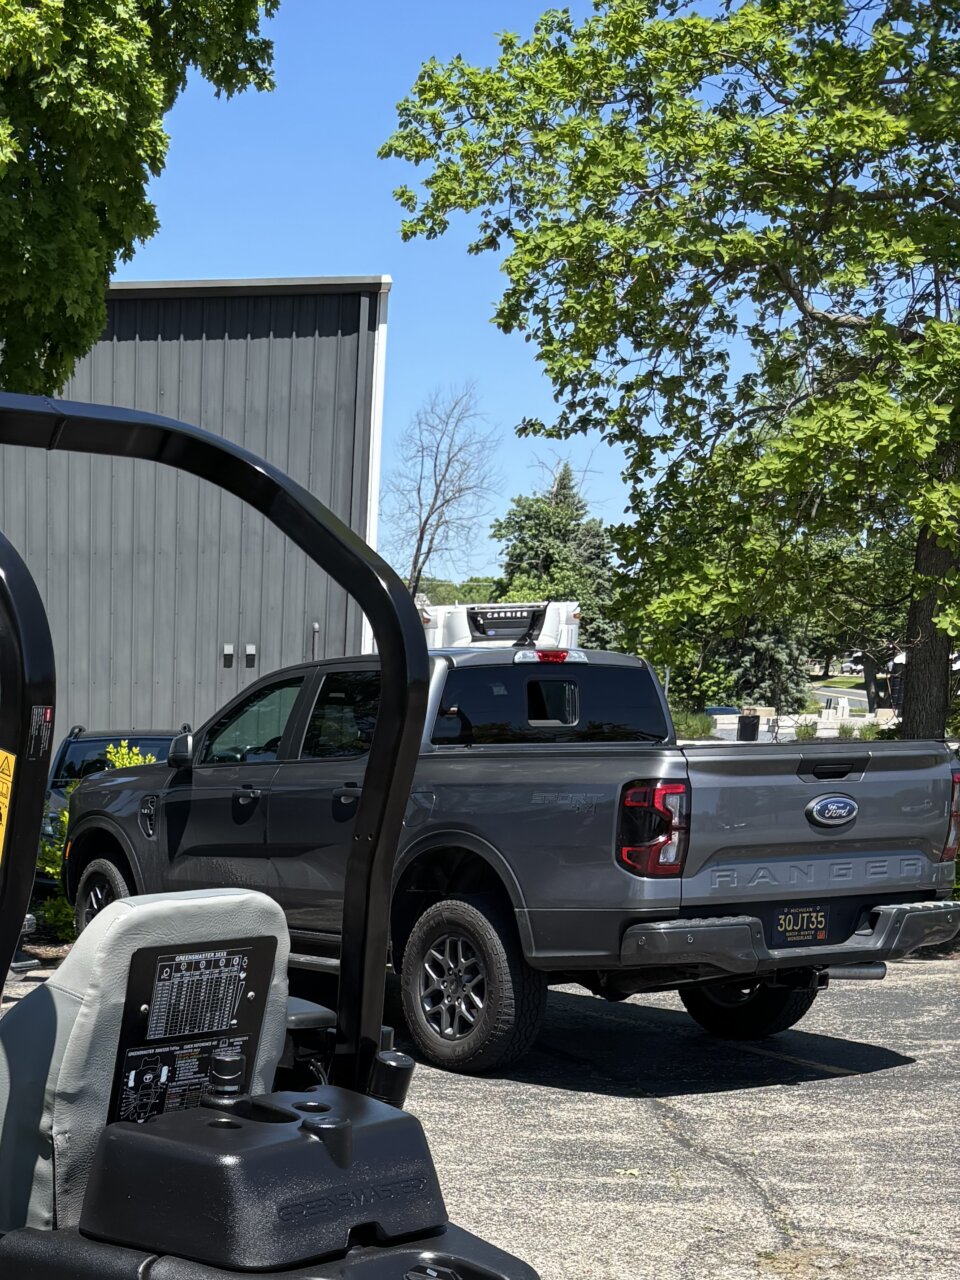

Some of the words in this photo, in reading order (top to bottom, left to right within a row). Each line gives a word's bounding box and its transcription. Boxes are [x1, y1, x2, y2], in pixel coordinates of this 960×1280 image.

[824, 802, 850, 818] Ford
[710, 857, 923, 888] RANGER
[777, 912, 825, 932] 3QJT35
